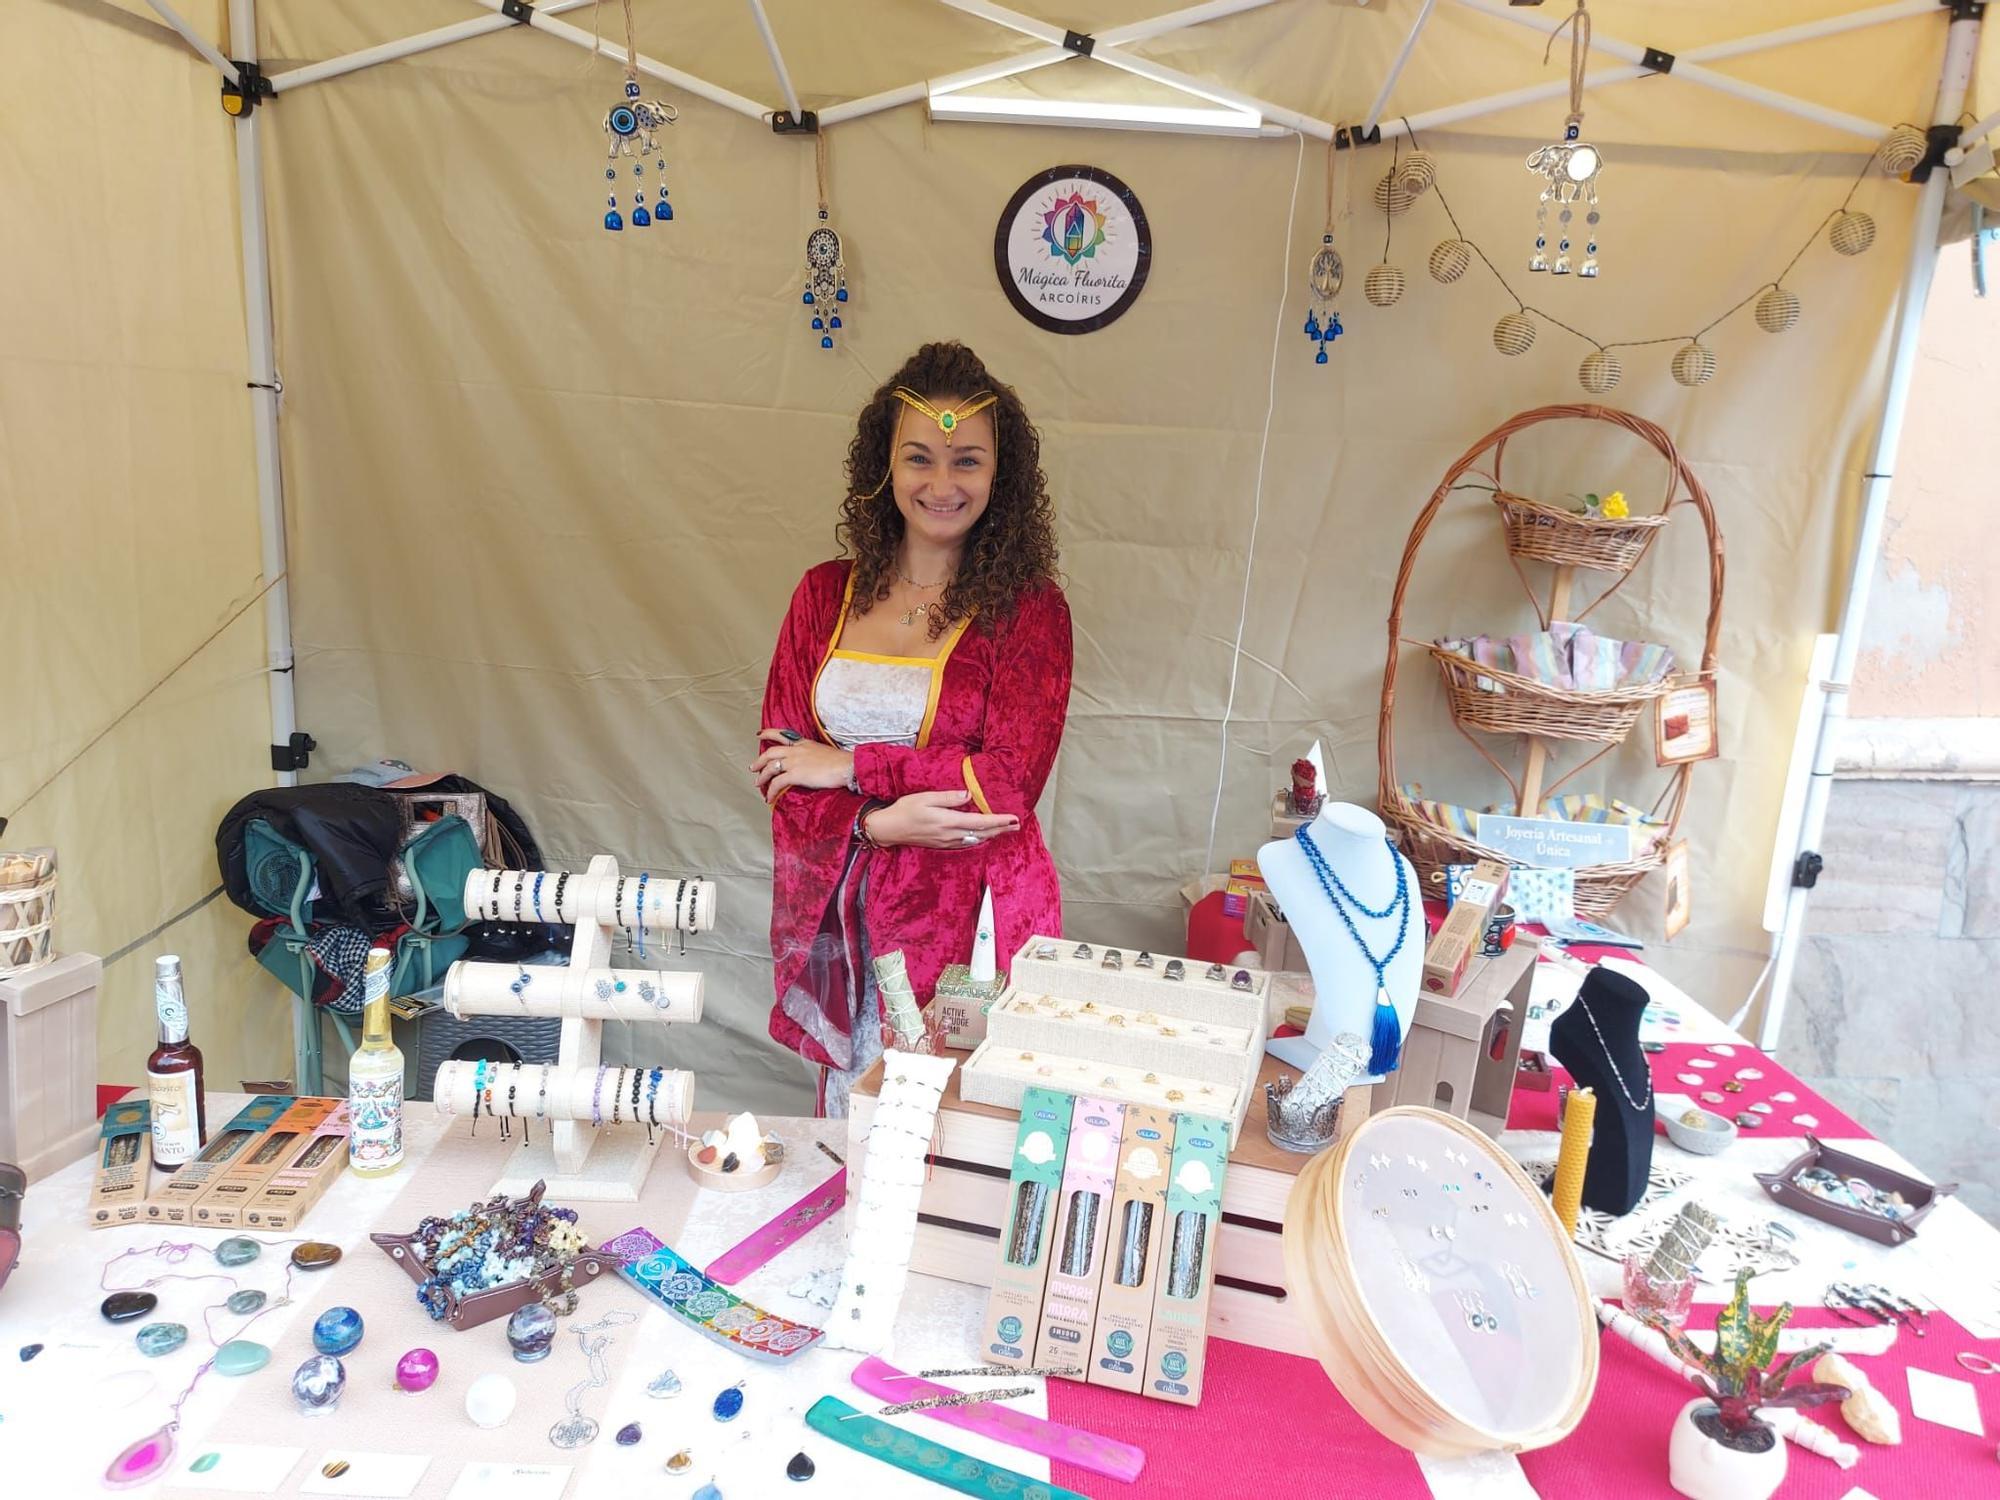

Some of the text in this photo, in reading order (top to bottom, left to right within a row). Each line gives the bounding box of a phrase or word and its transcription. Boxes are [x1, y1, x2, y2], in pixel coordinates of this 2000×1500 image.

[1018, 267, 1127, 290] Mágica Fluorita
[1039, 291, 1102, 305] ARCOÍRIS
[1546, 828, 1602, 845] Artesanal
[1536, 843, 1571, 857] Única
[942, 1006, 967, 1018] ACTIVE
[942, 1016, 970, 1028] UDGE
